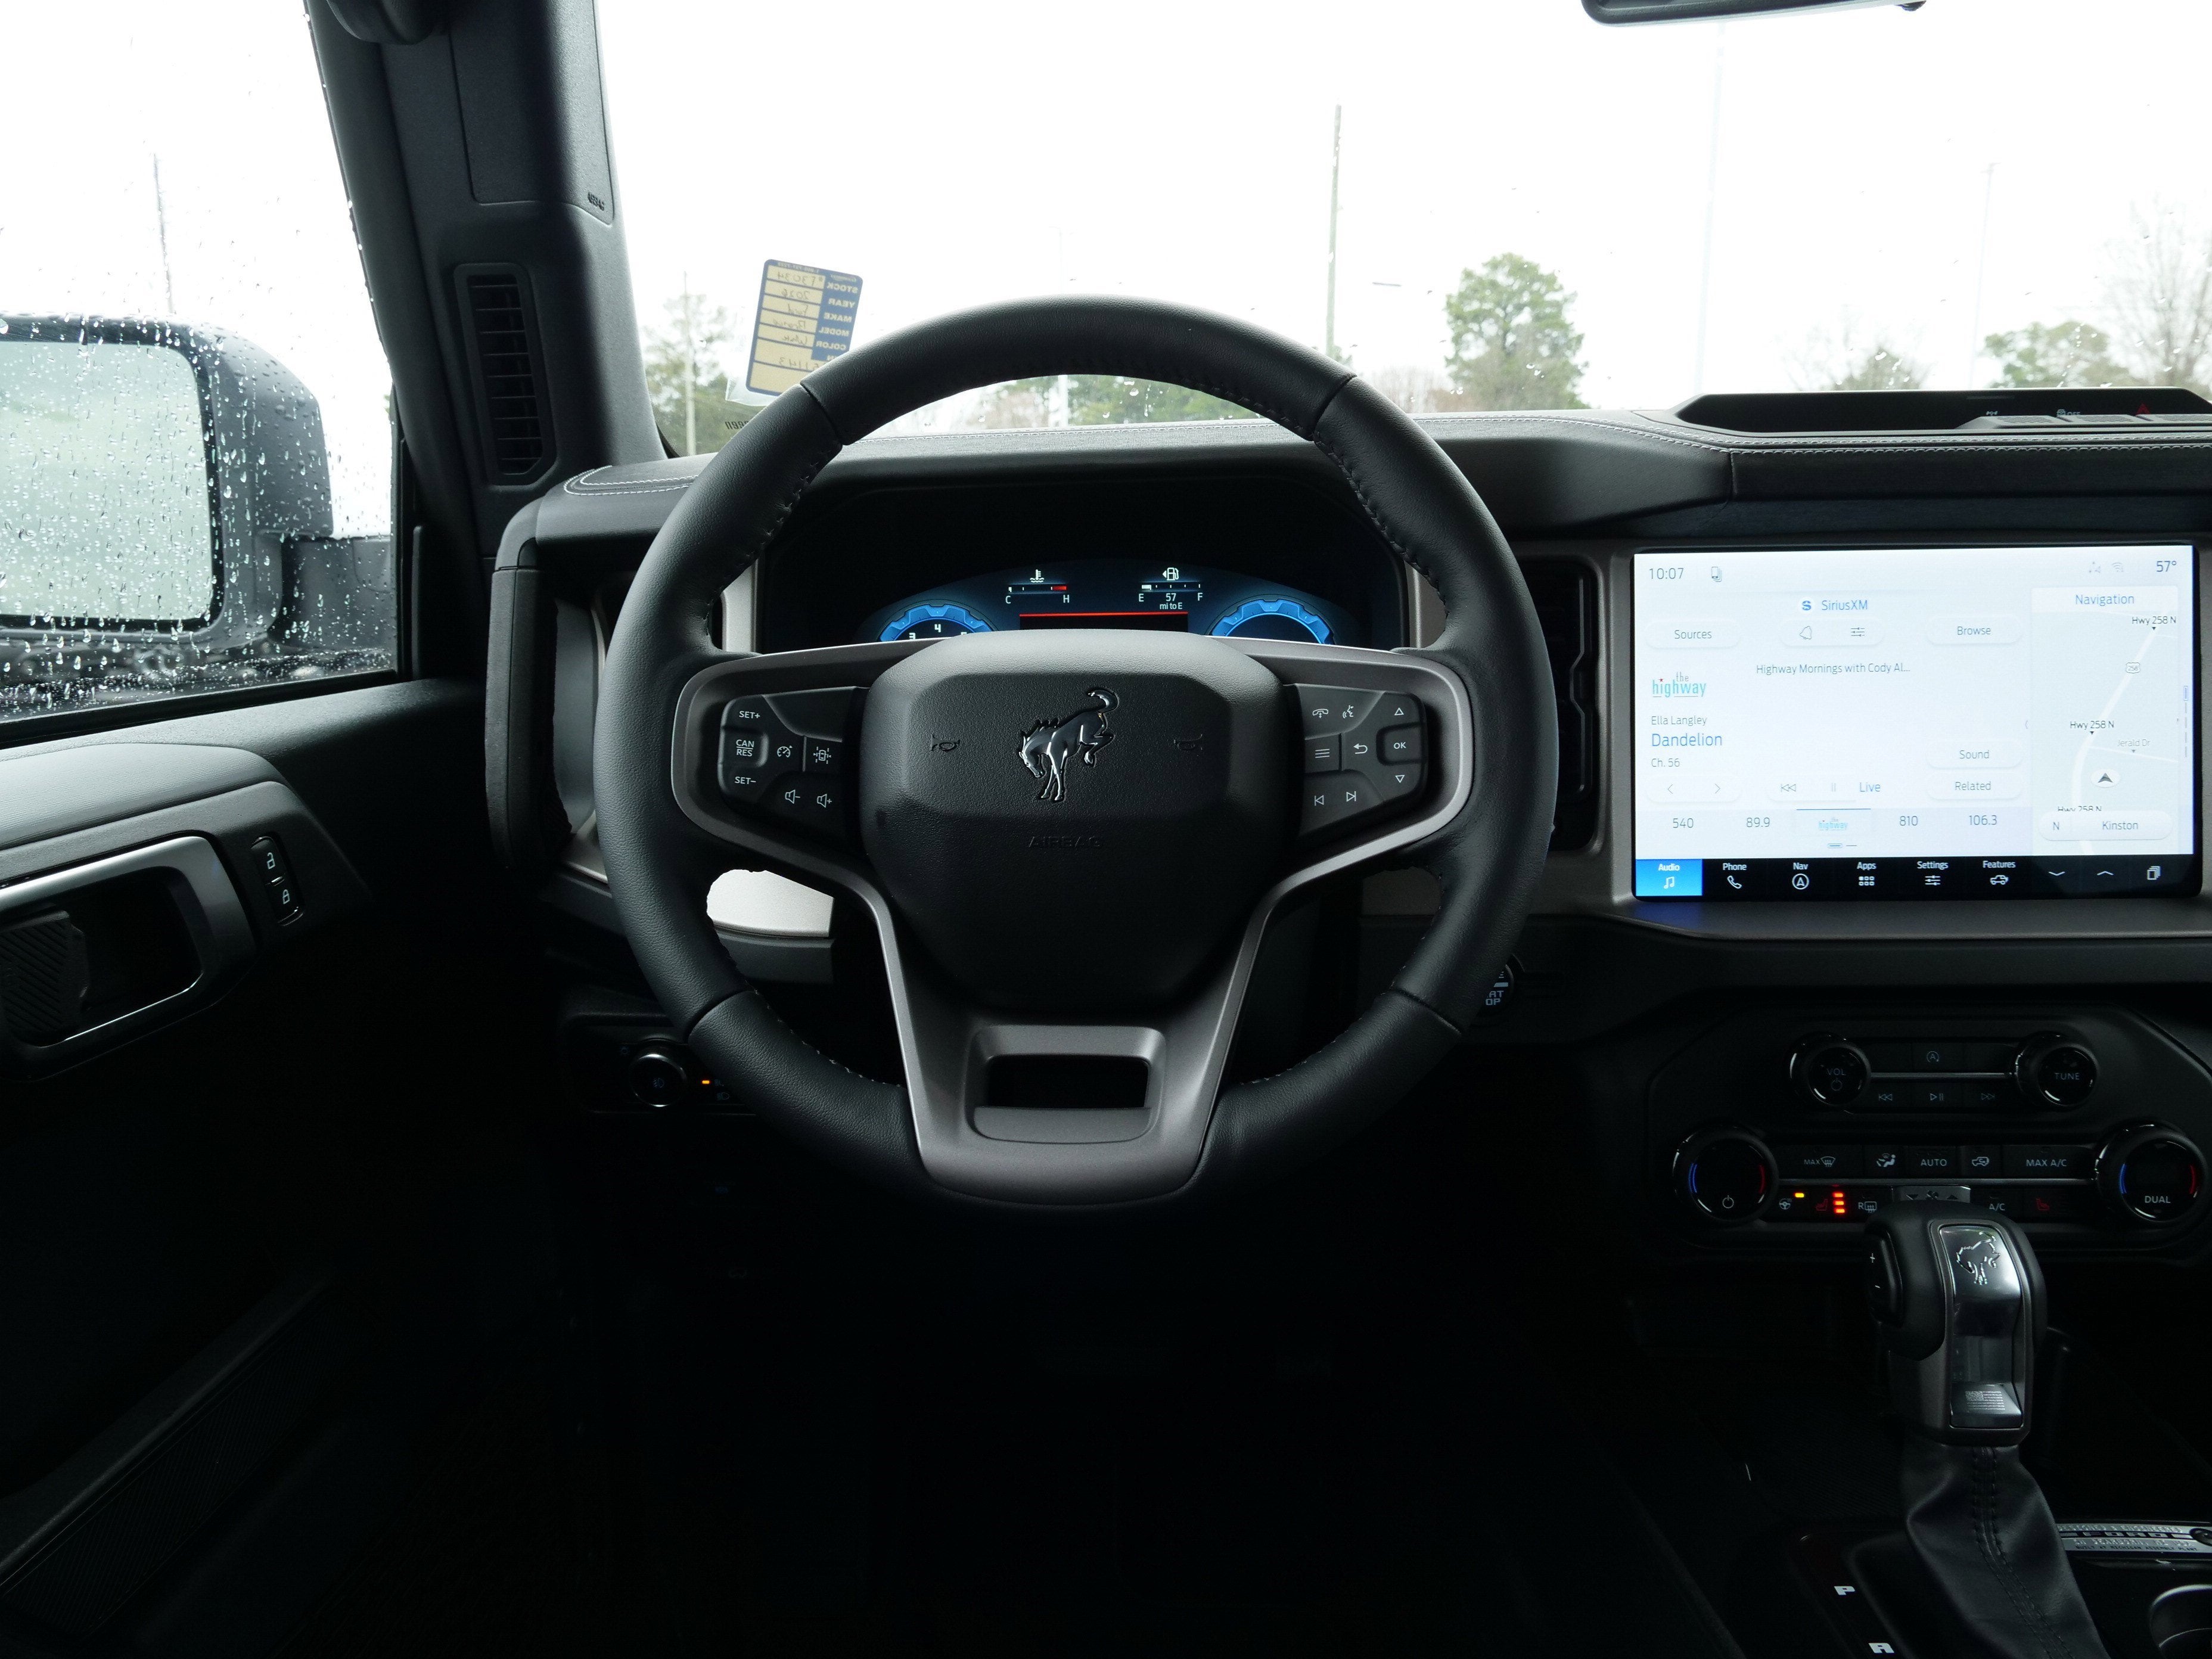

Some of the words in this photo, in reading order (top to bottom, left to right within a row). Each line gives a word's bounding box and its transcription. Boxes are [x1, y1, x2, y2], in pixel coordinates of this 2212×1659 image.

[2156, 561, 2177, 573] 57°
[1649, 567, 1684, 580] 10:07
[1005, 596, 1011, 604] C
[1166, 593, 1176, 602] 57
[2075, 594, 2135, 607] Navigation
[1821, 599, 1868, 611] SiriusXM
[2132, 616, 2150, 626] Hwy
[2152, 616, 2168, 625] 258
[934, 624, 941, 632] 4
[1957, 626, 1992, 636] Browse
[1674, 628, 1712, 640] Sources
[1756, 664, 1797, 676] Highway
[1799, 663, 1843, 675] Mornings
[1844, 663, 1866, 673] with
[1868, 663, 1891, 675] Cody
[1676, 672, 1689, 682] the
[1652, 679, 1706, 698] highway
[1651, 716, 1669, 726] Ella
[1671, 716, 1707, 727] Langley
[2070, 721, 2088, 730] Hwy
[2090, 720, 2107, 729] 258
[736, 740, 754, 748] CAN
[1651, 732, 1723, 747] Dandelion
[1959, 750, 1990, 759] Sound
[1651, 758, 1666, 768] Ch.
[1668, 758, 1680, 768] 56
[1859, 782, 1881, 793] Live
[1955, 781, 1992, 791] Related
[1672, 818, 1694, 829] 540
[1746, 817, 1770, 828] 89.9
[1899, 816, 1918, 827] 810
[1969, 815, 1997, 826] 106.3
[1819, 821, 1848, 831] highway
[2052, 822, 2059, 830] N
[2102, 821, 2138, 831] Kinston
[1028, 835, 1100, 847] AIRBAG
[1658, 863, 1680, 872] Audio
[1723, 862, 1747, 871] Phone
[1793, 862, 1809, 871] Nav
[1857, 862, 1876, 872] Apps
[1917, 860, 1949, 870] Settings
[1983, 860, 2015, 869] Features
[1827, 1067, 1847, 1076] VOL
[2055, 1072, 2080, 1081] TUNE
[1921, 1158, 1947, 1167] AUTO
[2051, 1158, 2067, 1167] A/C
[2144, 1195, 2171, 1204] DUAL
[1989, 1203, 2005, 1211] A/C
[1834, 1586, 1855, 1595] P
